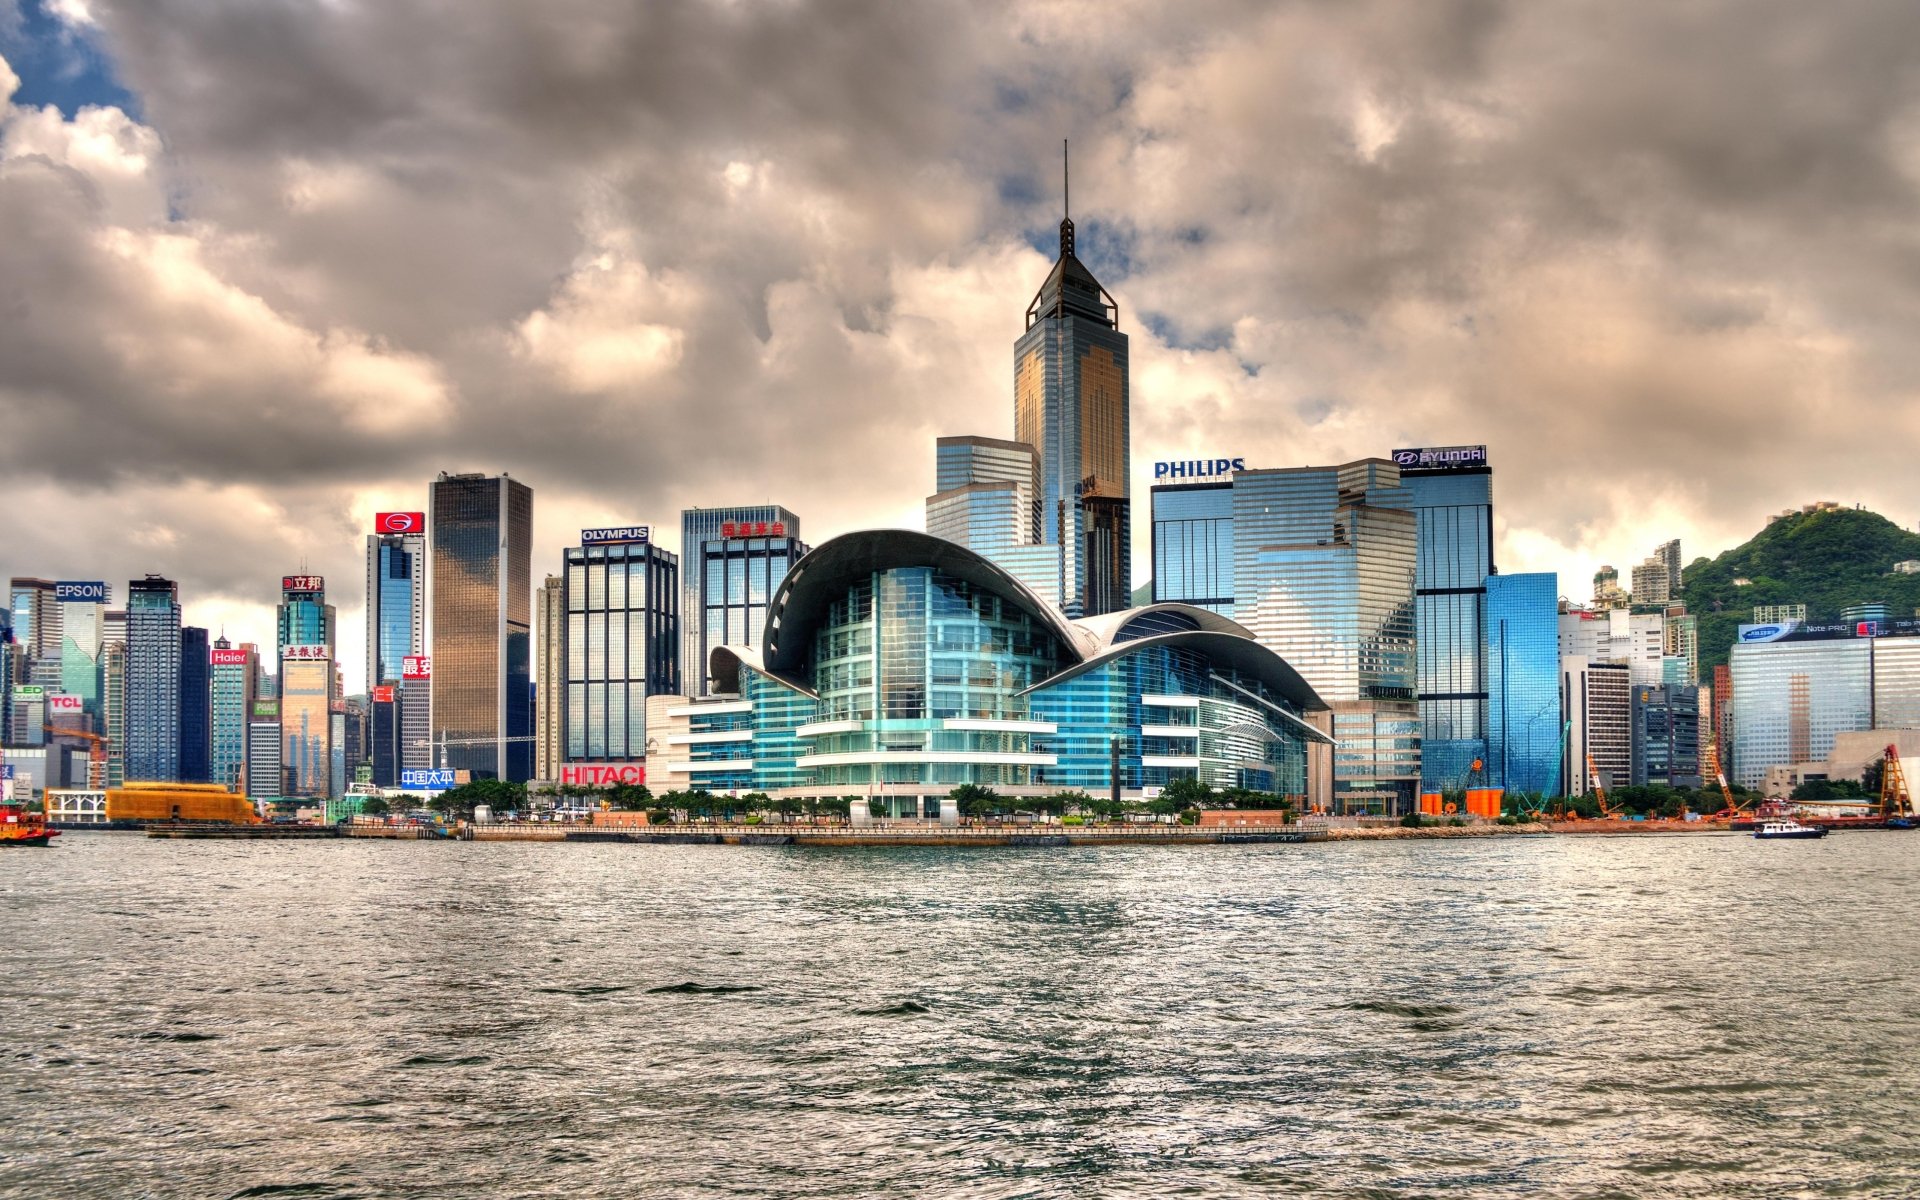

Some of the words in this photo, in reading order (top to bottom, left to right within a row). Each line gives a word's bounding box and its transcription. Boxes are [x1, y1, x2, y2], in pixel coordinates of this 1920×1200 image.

[1420, 450, 1485, 462] HYUNDAI
[1155, 458, 1244, 478] PHILIPS
[582, 528, 648, 540] OLYMPUS
[293, 576, 322, 590] 立邦
[56, 585, 102, 597] EPSON
[1806, 625, 1826, 633] Note
[215, 652, 246, 662] Haier
[13, 686, 43, 694] LED
[51, 697, 82, 708] TCL
[401, 770, 454, 784] 中国太平
